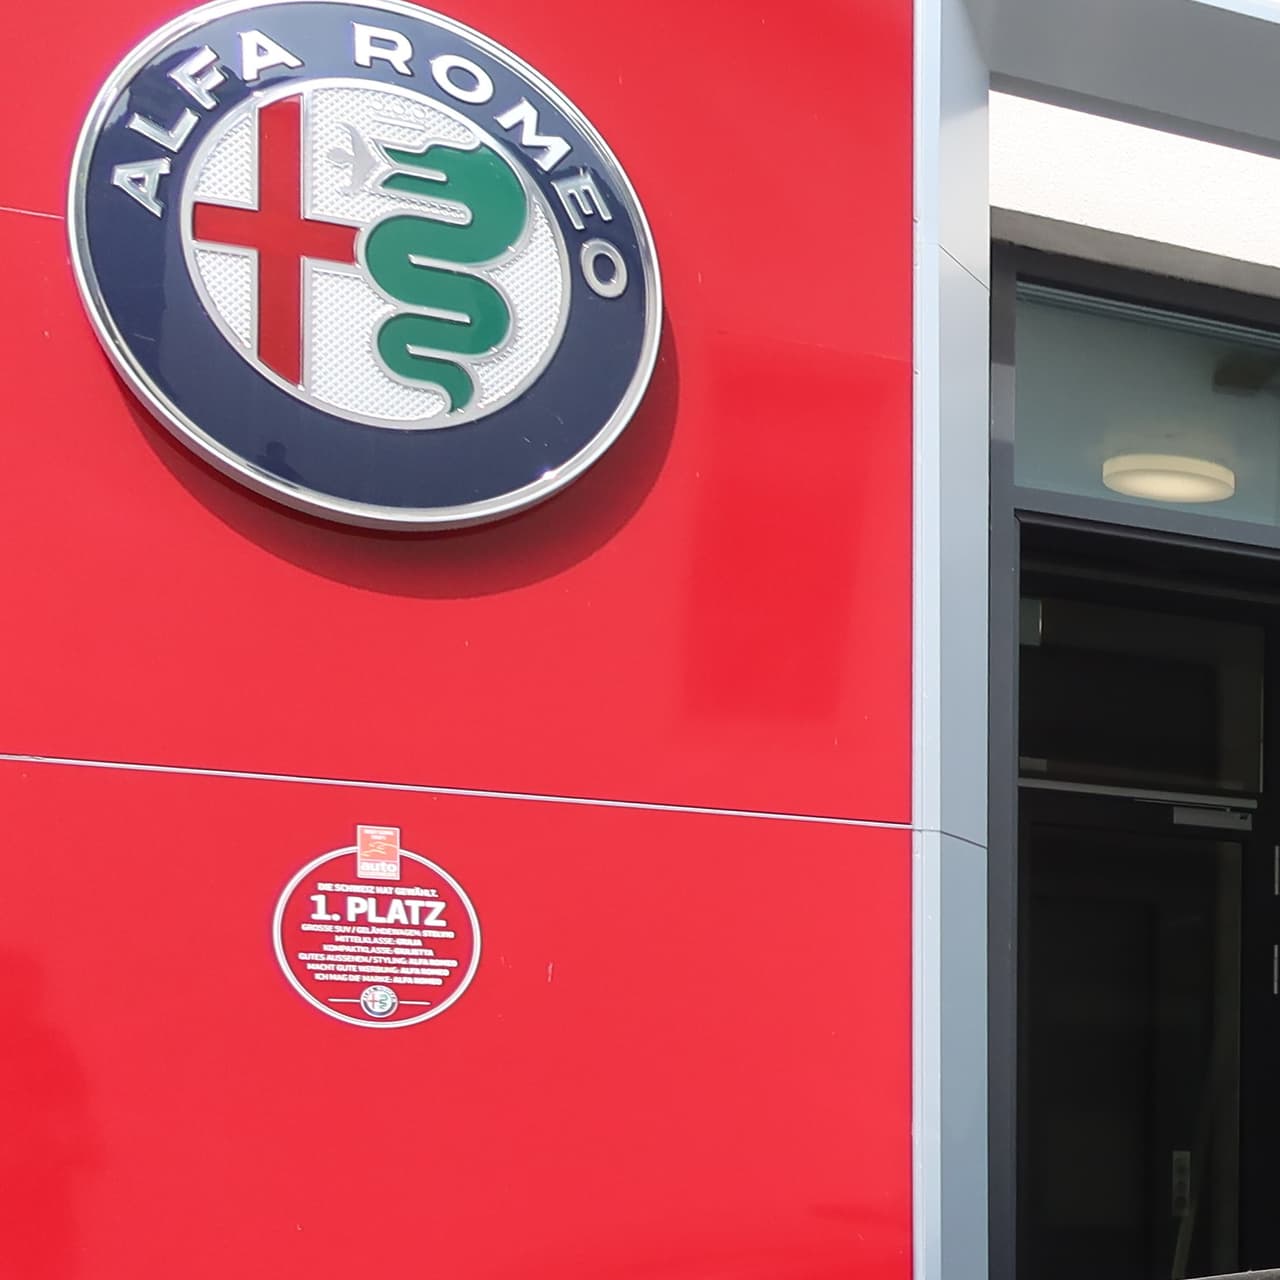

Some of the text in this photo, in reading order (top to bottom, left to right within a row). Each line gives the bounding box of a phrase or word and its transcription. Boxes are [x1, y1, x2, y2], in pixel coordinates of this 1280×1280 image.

[113, 21, 629, 299] ALFA ROMEO
[310, 895, 446, 927] 1. PLATZ
